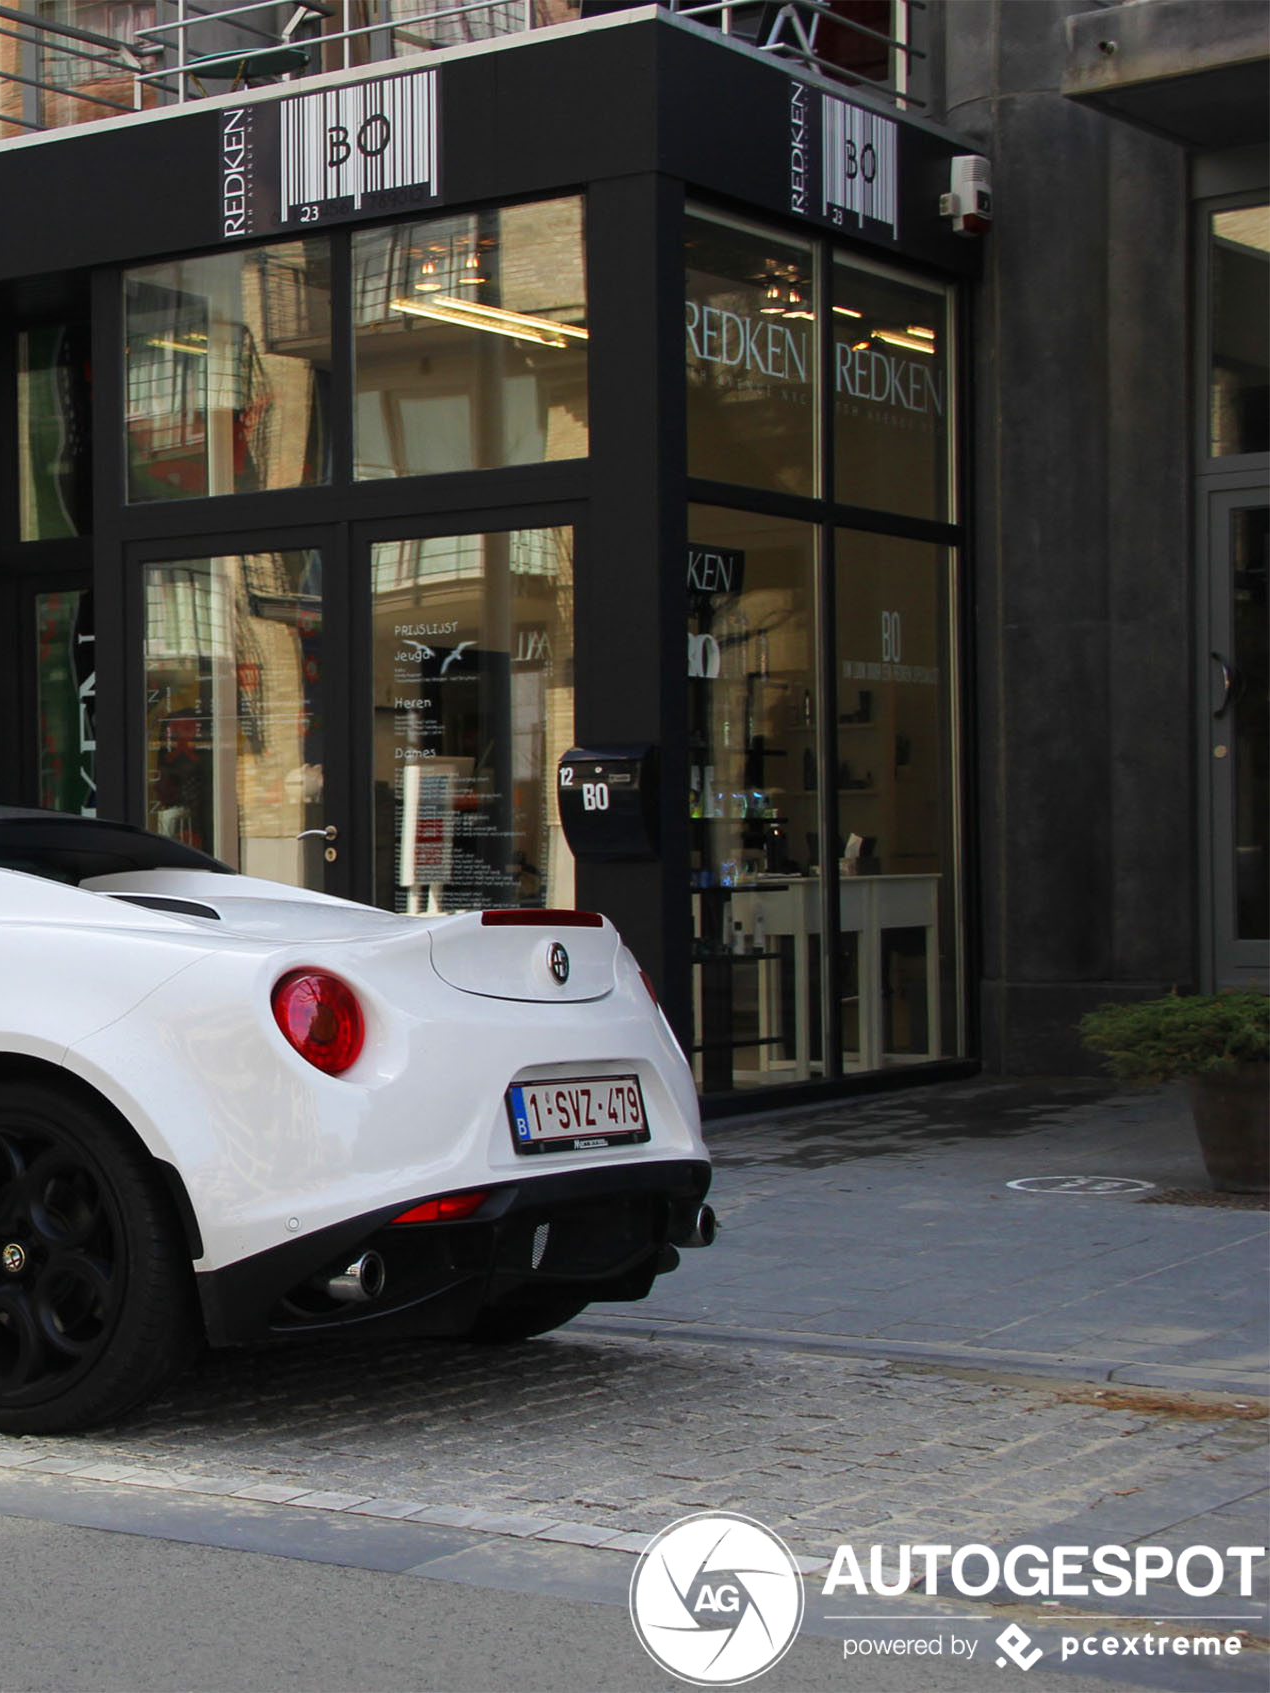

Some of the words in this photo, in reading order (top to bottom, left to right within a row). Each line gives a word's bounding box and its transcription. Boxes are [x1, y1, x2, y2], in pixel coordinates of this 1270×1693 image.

[328, 113, 391, 168] BO
[791, 81, 804, 214] REDKEN
[224, 109, 246, 237] REDKEN
[845, 139, 876, 184] BO
[300, 206, 319, 223] 23
[685, 301, 807, 384] REDKEN
[836, 342, 943, 416] REDKEN
[394, 621, 458, 636] PRIJSLIJST
[882, 610, 901, 663] BO
[394, 697, 432, 709] Heren
[394, 747, 436, 759] Dames
[559, 767, 573, 786] 12
[582, 782, 609, 810] BO
[516, 1118, 527, 1136] B
